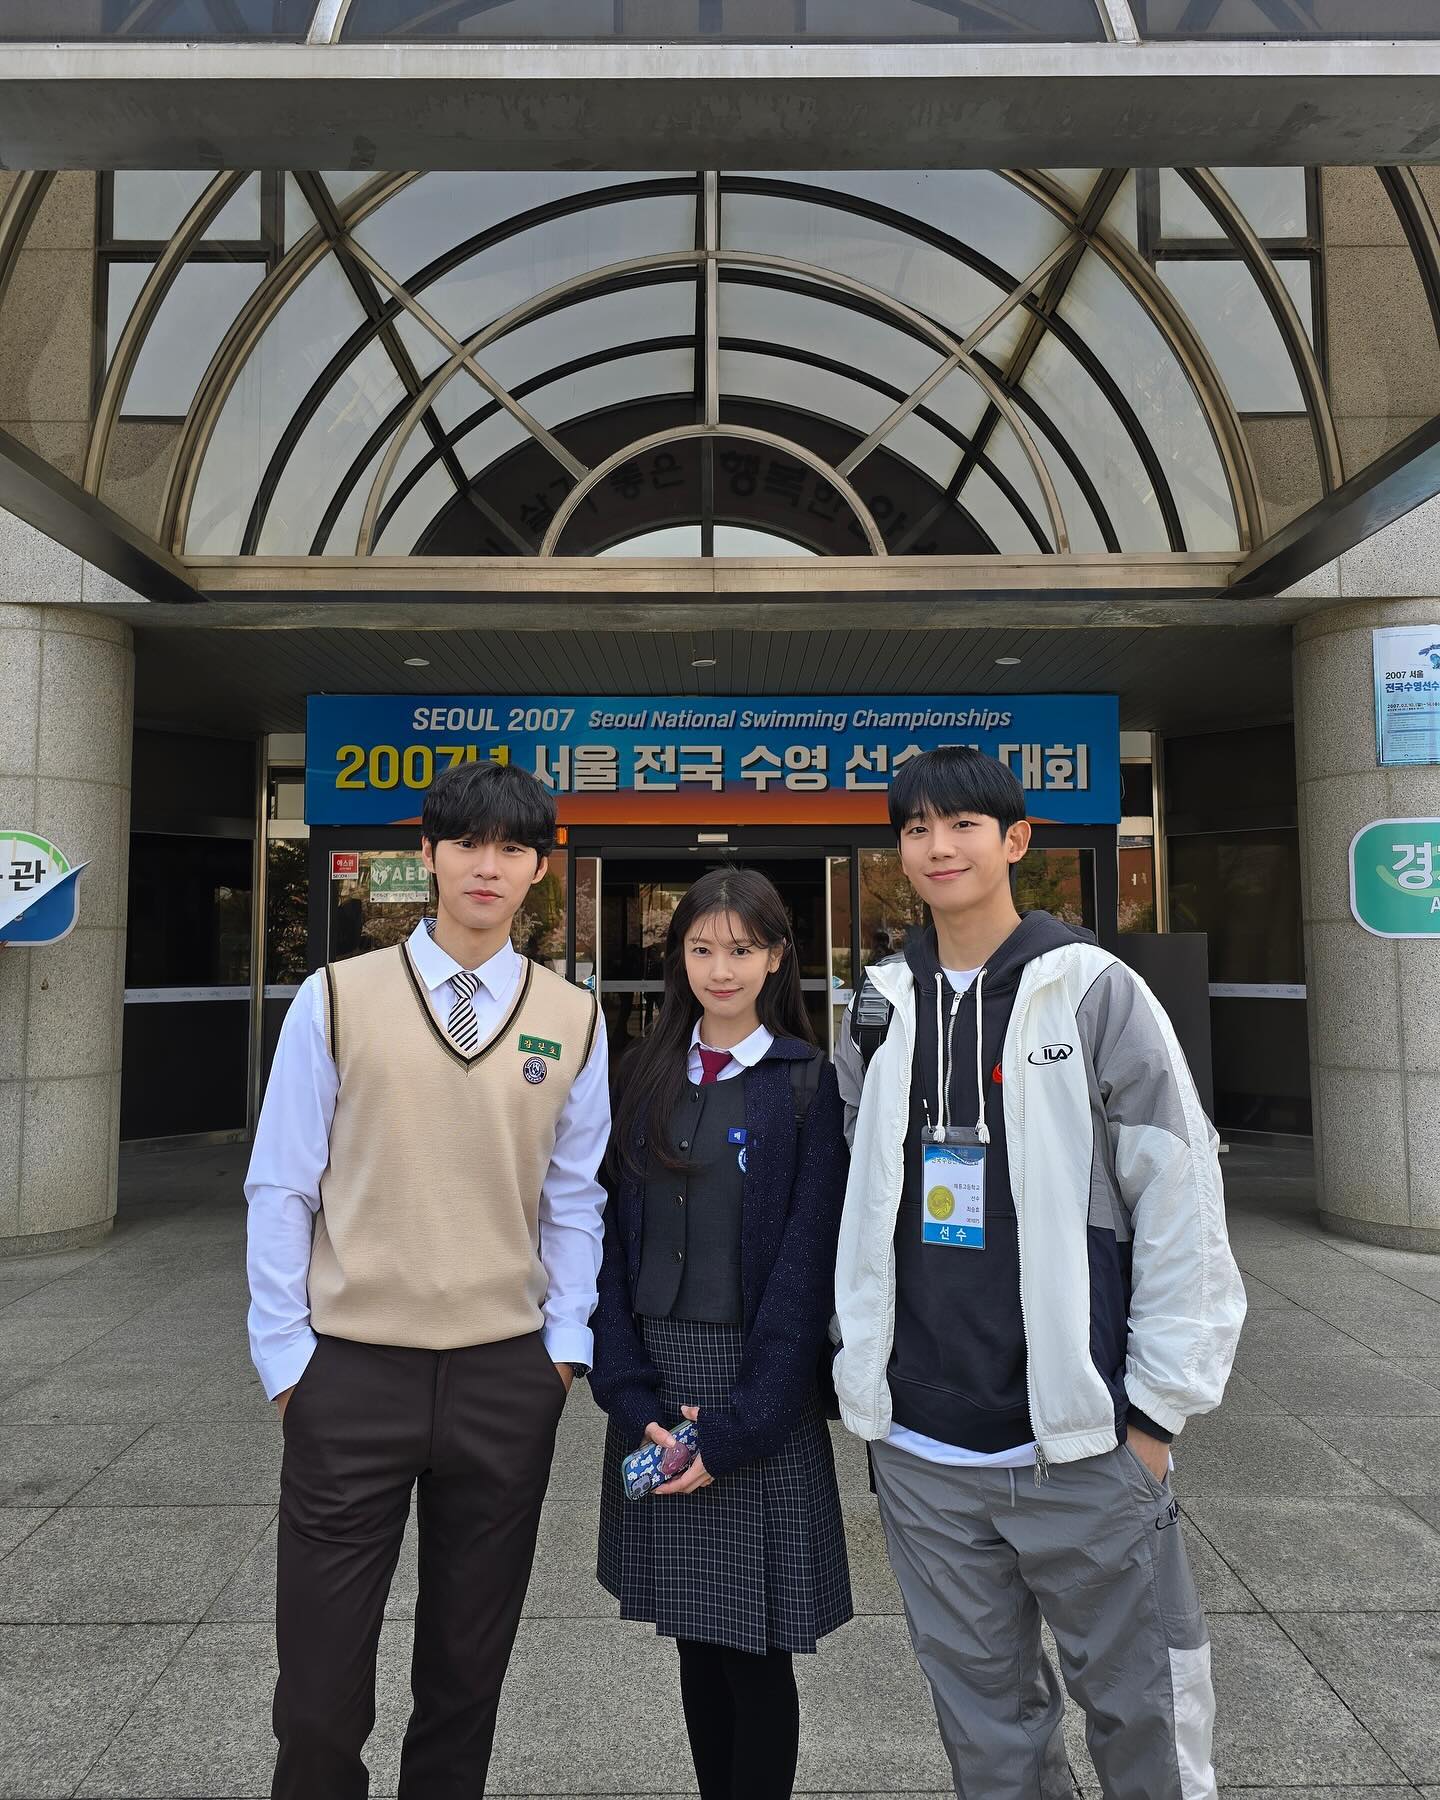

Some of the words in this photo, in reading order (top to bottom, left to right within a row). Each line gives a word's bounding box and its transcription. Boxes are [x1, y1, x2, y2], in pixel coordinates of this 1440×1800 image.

[1385, 671, 1407, 679] 2007
[1409, 670, 1424, 678] 서울
[412, 708, 500, 732] SEOUL
[507, 708, 575, 732] 2007
[588, 710, 647, 729] Seoul
[650, 710, 736, 729] National
[740, 710, 848, 733] Swimming
[852, 709, 1012, 732] Championships
[535, 745, 618, 791] 서울
[633, 745, 724, 791] 전국
[740, 744, 829, 791] 수영
[998, 743, 1089, 790] 대회
[336, 859, 354, 867] 에스원
[391, 867, 428, 881] AED
